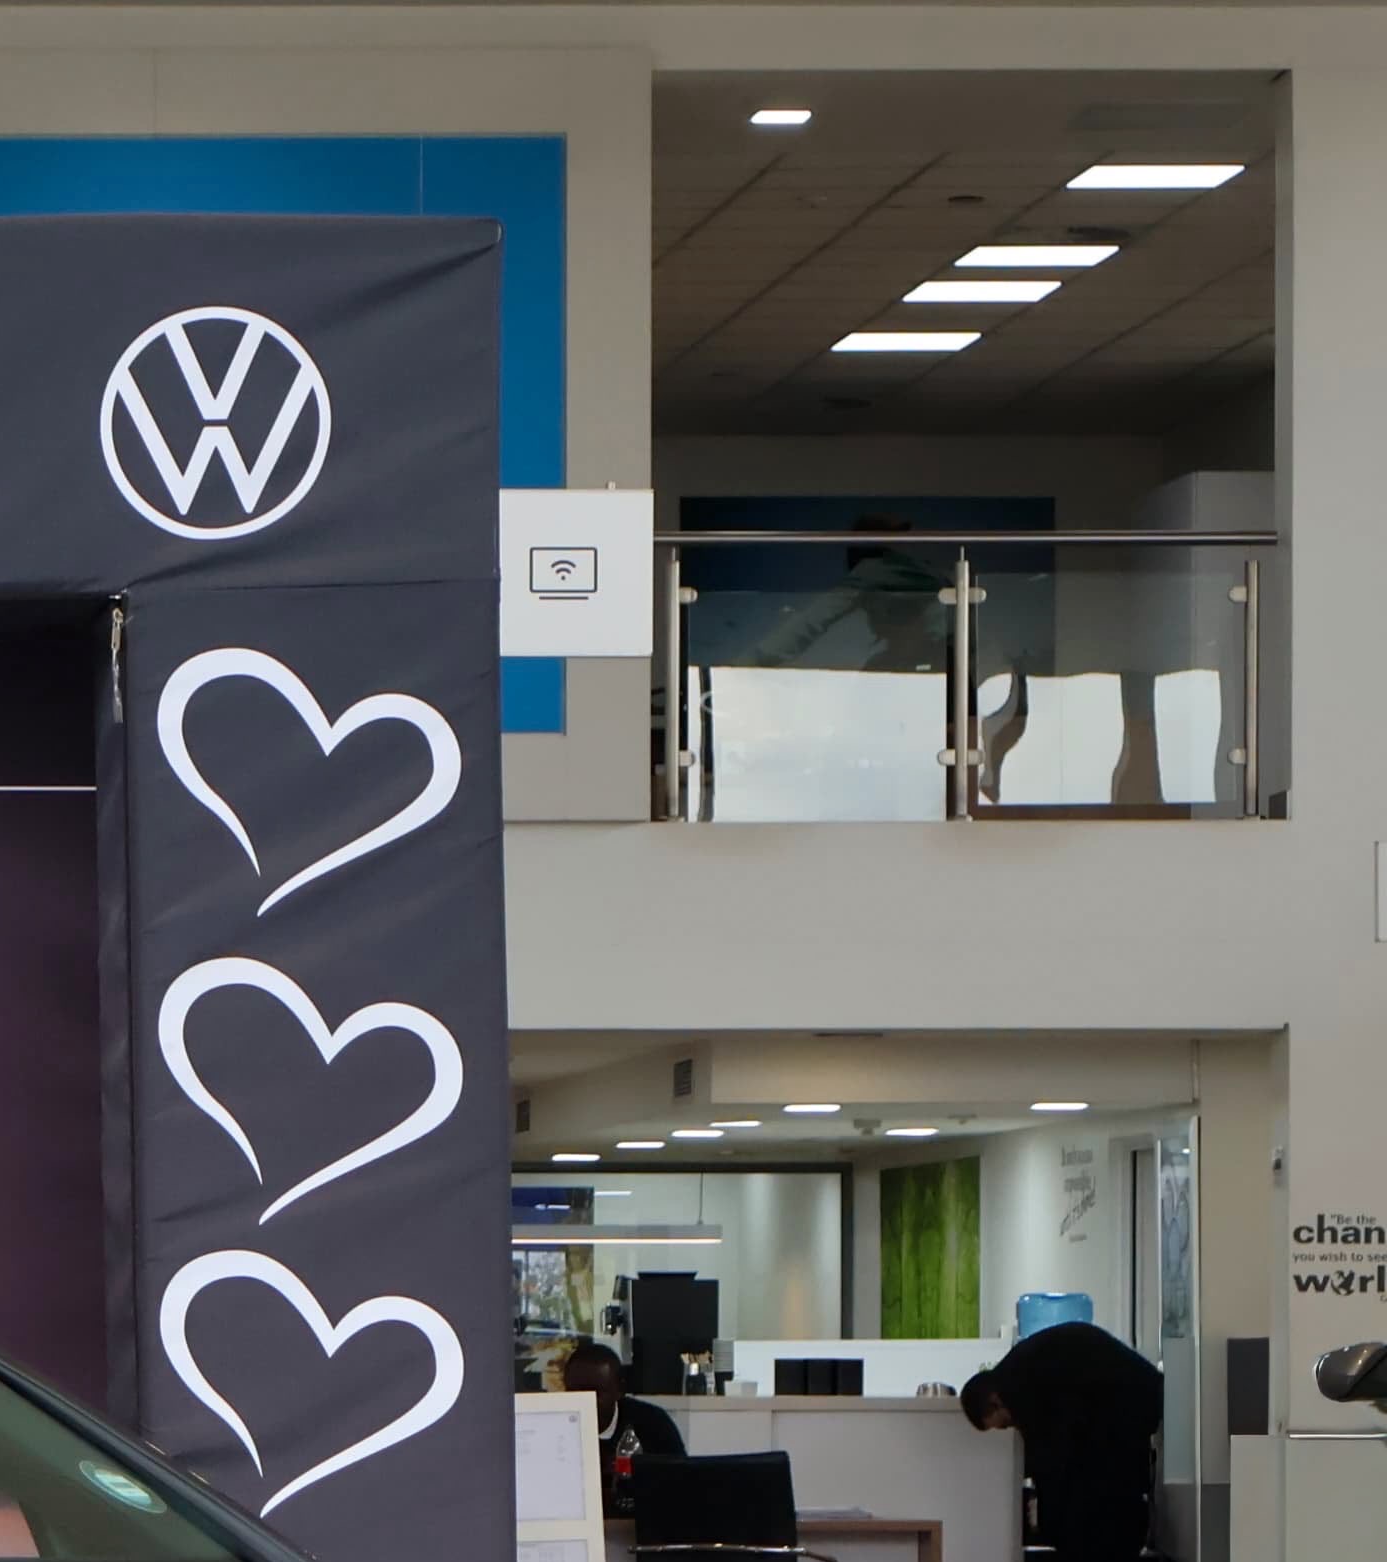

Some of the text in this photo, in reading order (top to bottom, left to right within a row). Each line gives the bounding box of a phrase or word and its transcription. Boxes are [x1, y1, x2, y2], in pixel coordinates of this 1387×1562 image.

[1356, 1213, 1377, 1225] the
[1292, 1252, 1316, 1264] you
[1318, 1251, 1348, 1263] wish
[1350, 1251, 1365, 1263] to
